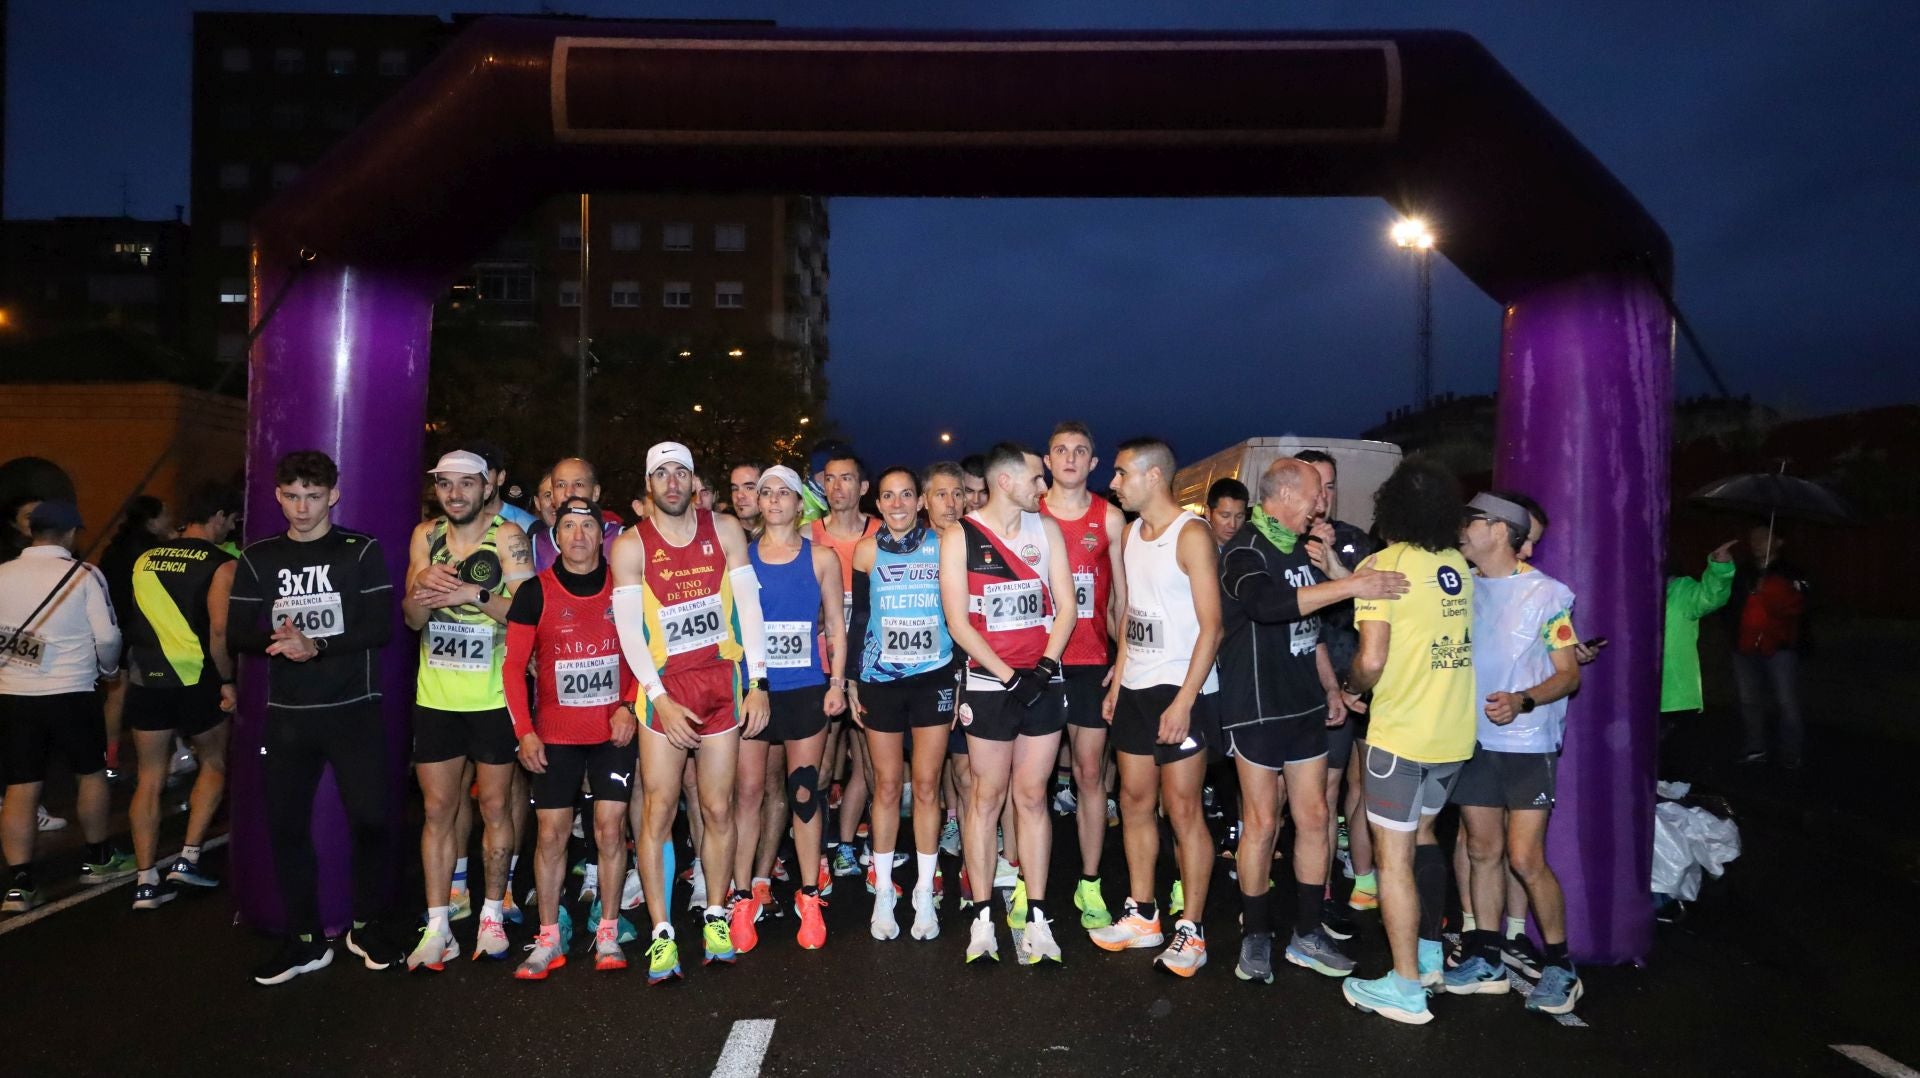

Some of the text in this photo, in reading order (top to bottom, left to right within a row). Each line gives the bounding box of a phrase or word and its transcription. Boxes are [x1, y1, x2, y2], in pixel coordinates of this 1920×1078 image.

[143, 560, 187, 573] PALENCIA
[278, 564, 334, 597] 3x7K
[909, 569, 940, 581] ULSA
[1440, 572, 1459, 589] 13
[675, 579, 702, 590] VINO
[1003, 582, 1031, 591] PALENCIA
[667, 587, 711, 601] DE TORO
[291, 597, 322, 606] PALENCIA
[678, 600, 707, 613] PALENCIA
[447, 625, 475, 634] PALENCIA
[666, 611, 720, 642] 2450
[1127, 620, 1154, 643] 2301
[888, 630, 933, 650] 2043
[432, 635, 484, 659] 2412
[575, 659, 605, 669] PALENCIA
[563, 669, 613, 694] 2044
